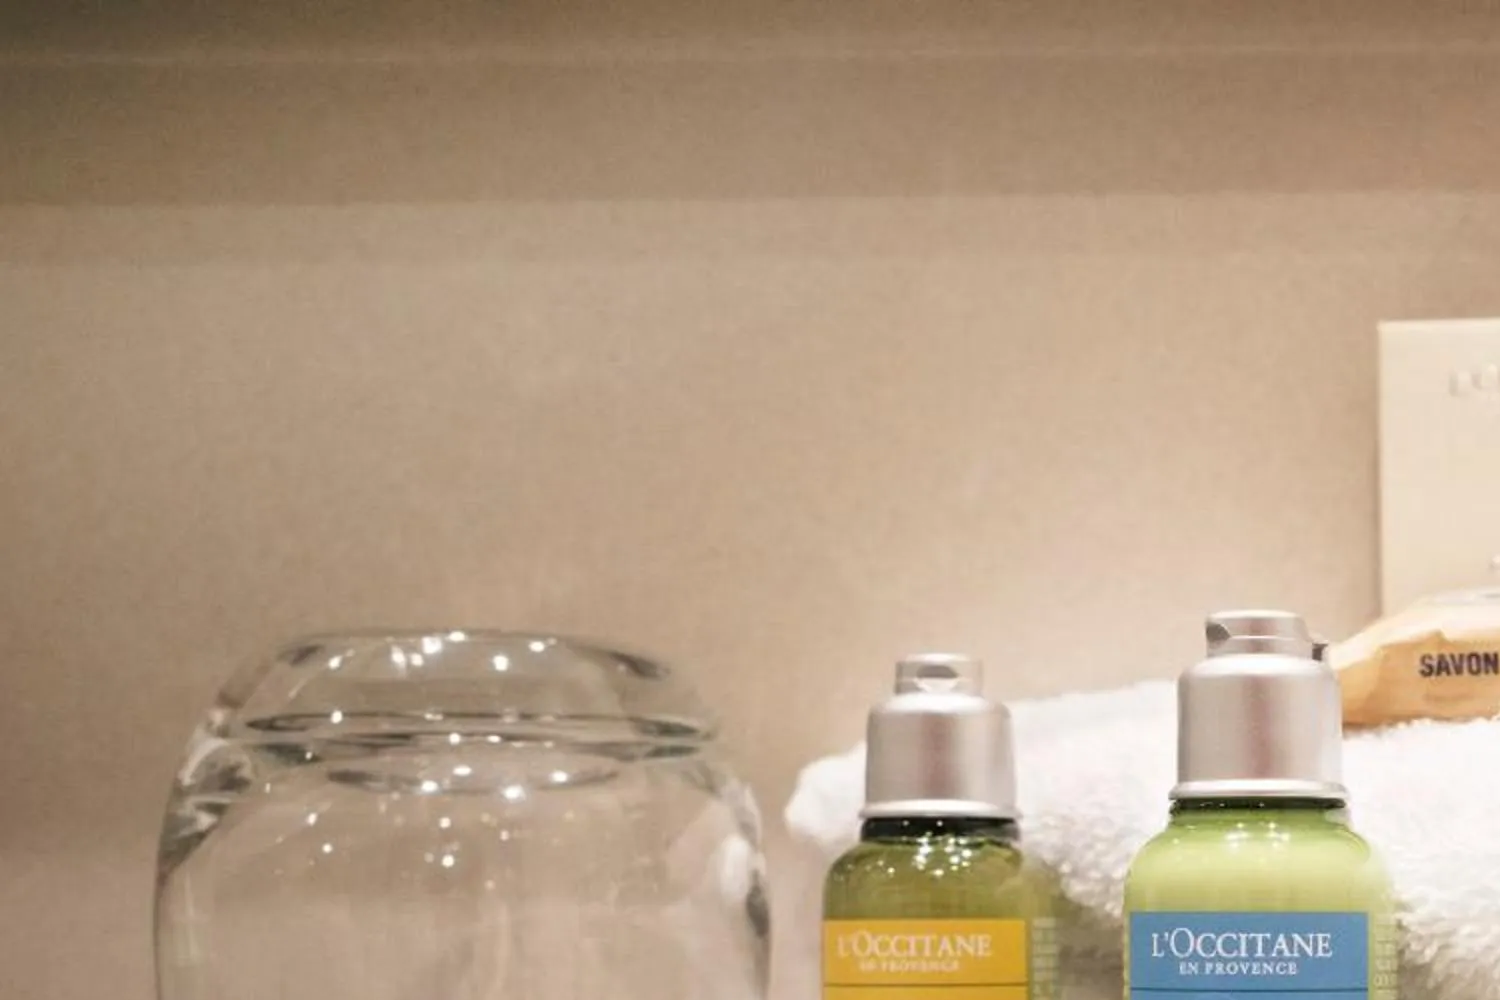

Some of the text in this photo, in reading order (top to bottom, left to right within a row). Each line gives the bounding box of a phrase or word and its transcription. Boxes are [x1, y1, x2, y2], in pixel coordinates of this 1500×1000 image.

[1418, 652, 1499, 678] SAVON
[837, 930, 993, 958] L'OCCITANE
[1151, 928, 1333, 958] L'OCCITANE
[1179, 961, 1298, 975] EN PROVENCE
